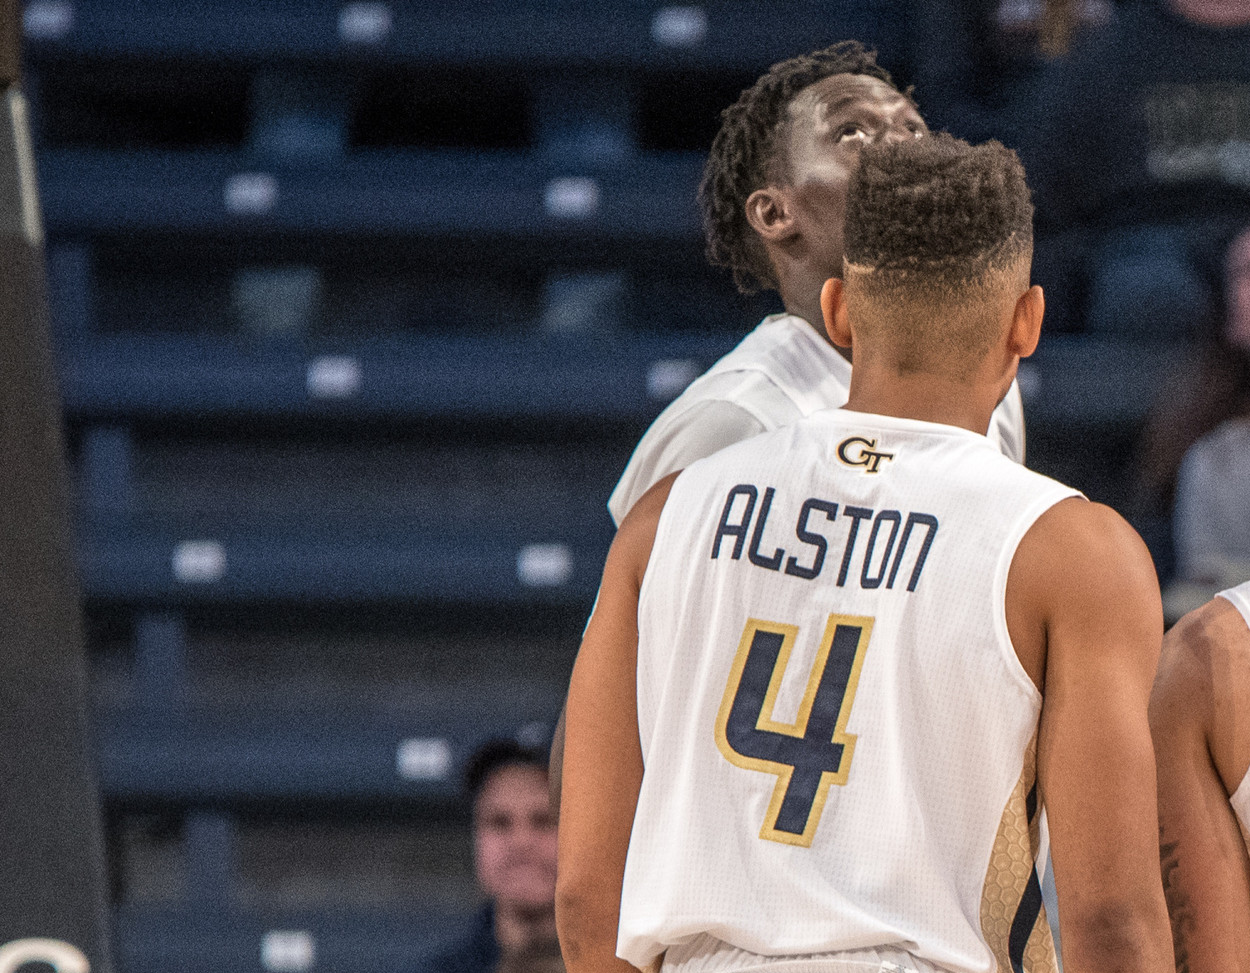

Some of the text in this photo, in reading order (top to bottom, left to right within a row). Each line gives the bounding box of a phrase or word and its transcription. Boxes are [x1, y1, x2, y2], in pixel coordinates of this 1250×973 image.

[836, 437, 894, 474] GT
[711, 484, 938, 592] ALSTON
[714, 612, 876, 849] 4
